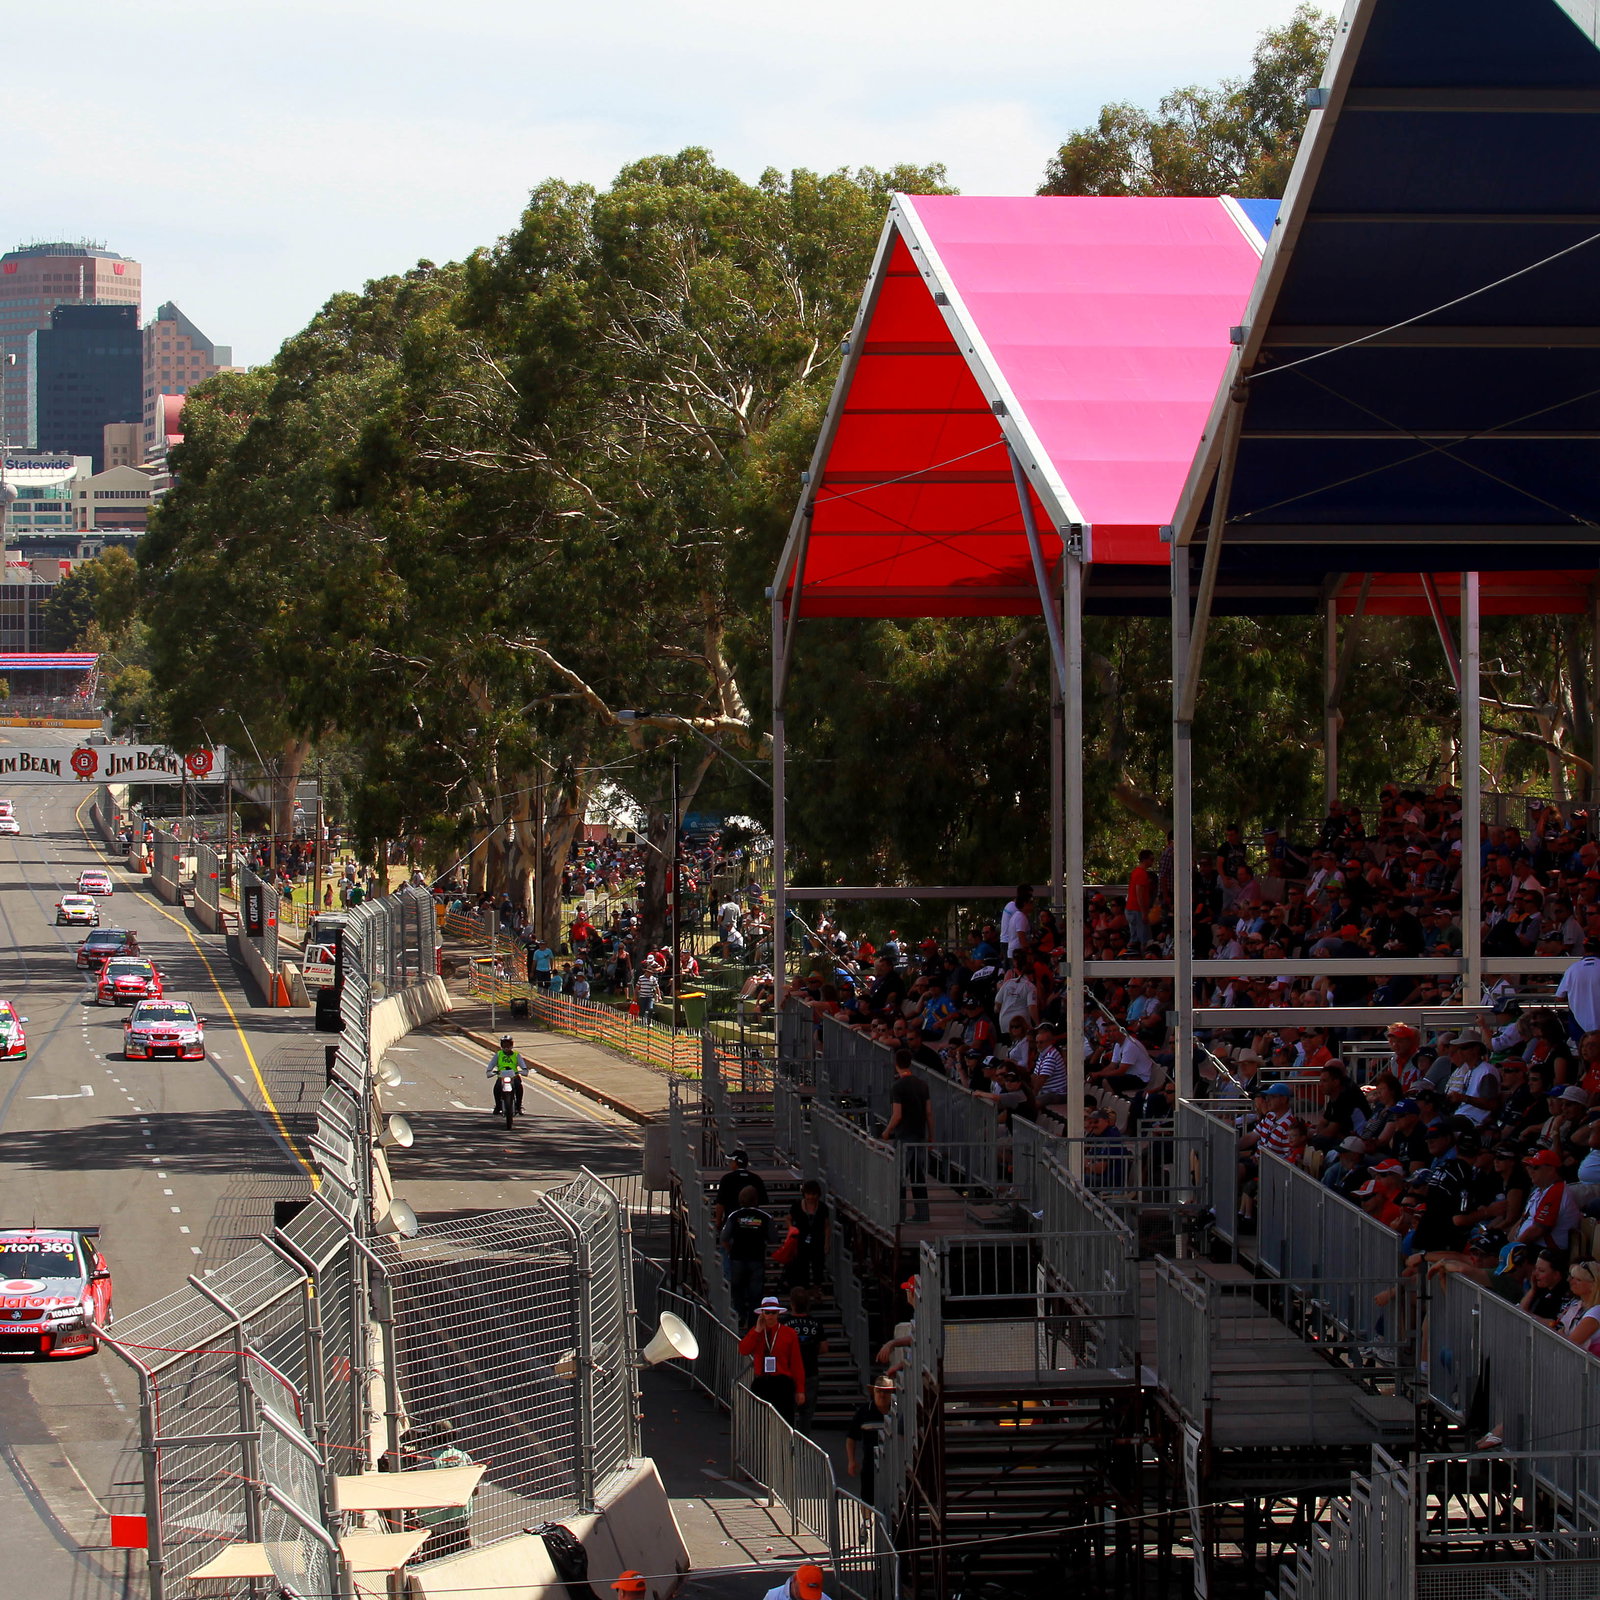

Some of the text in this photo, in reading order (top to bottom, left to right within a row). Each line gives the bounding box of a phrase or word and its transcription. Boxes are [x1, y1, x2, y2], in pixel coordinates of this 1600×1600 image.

[6, 459, 71, 470] Statewide
[0, 752, 62, 777] IM BEAM
[105, 751, 179, 777] JIM BEAM
[249, 895, 259, 922] CLIPSAL
[0, 1242, 75, 1253] orton 360
[65, 1253, 74, 1261] 1
[62, 1333, 89, 1344] HOLDEN
